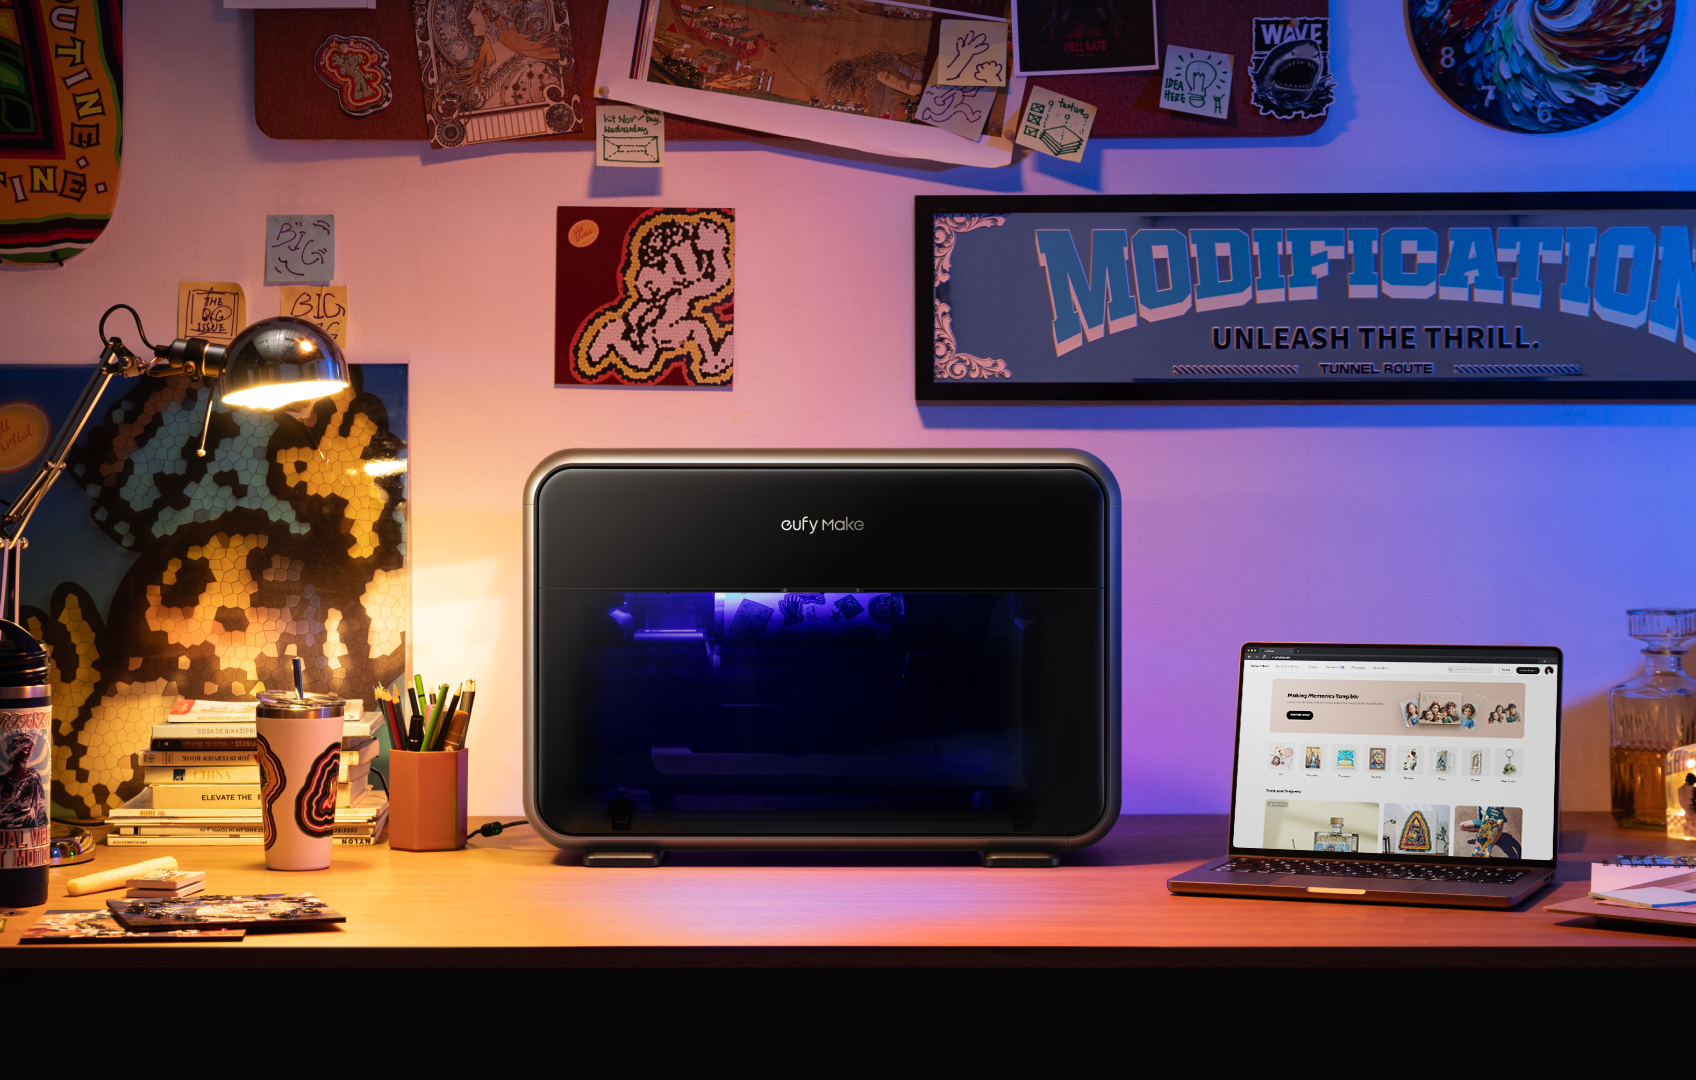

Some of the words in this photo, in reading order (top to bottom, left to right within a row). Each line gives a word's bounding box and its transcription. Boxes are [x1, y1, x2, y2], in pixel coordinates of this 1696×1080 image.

[1261, 23, 1322, 45] WAVE
[1440, 46, 1455, 69] 8
[1632, 45, 1649, 67] 4
[50, 0, 105, 148] UTINE
[1165, 78, 1184, 91] IDEA
[1164, 90, 1186, 103] HERE
[1478, 86, 1495, 107] 7
[1537, 102, 1552, 123] 6
[0, 165, 87, 203] INE
[272, 222, 324, 266] BIG
[203, 295, 224, 307] THE
[1035, 225, 1696, 357] MODIFICATION
[291, 292, 346, 319] BIG
[191, 322, 226, 335] ISSUE
[1212, 326, 1350, 350] UNLEASH
[1358, 326, 1417, 350] THE
[1423, 325, 1541, 350] THRILL.
[1318, 362, 1381, 375] TUNNEL
[1383, 362, 1434, 375] ROUTE
[781, 516, 818, 535] eufy
[822, 516, 865, 531] Make
[1287, 692, 1308, 700] Making
[1335, 692, 1359, 700] Tangible
[193, 770, 231, 780] CHINA
